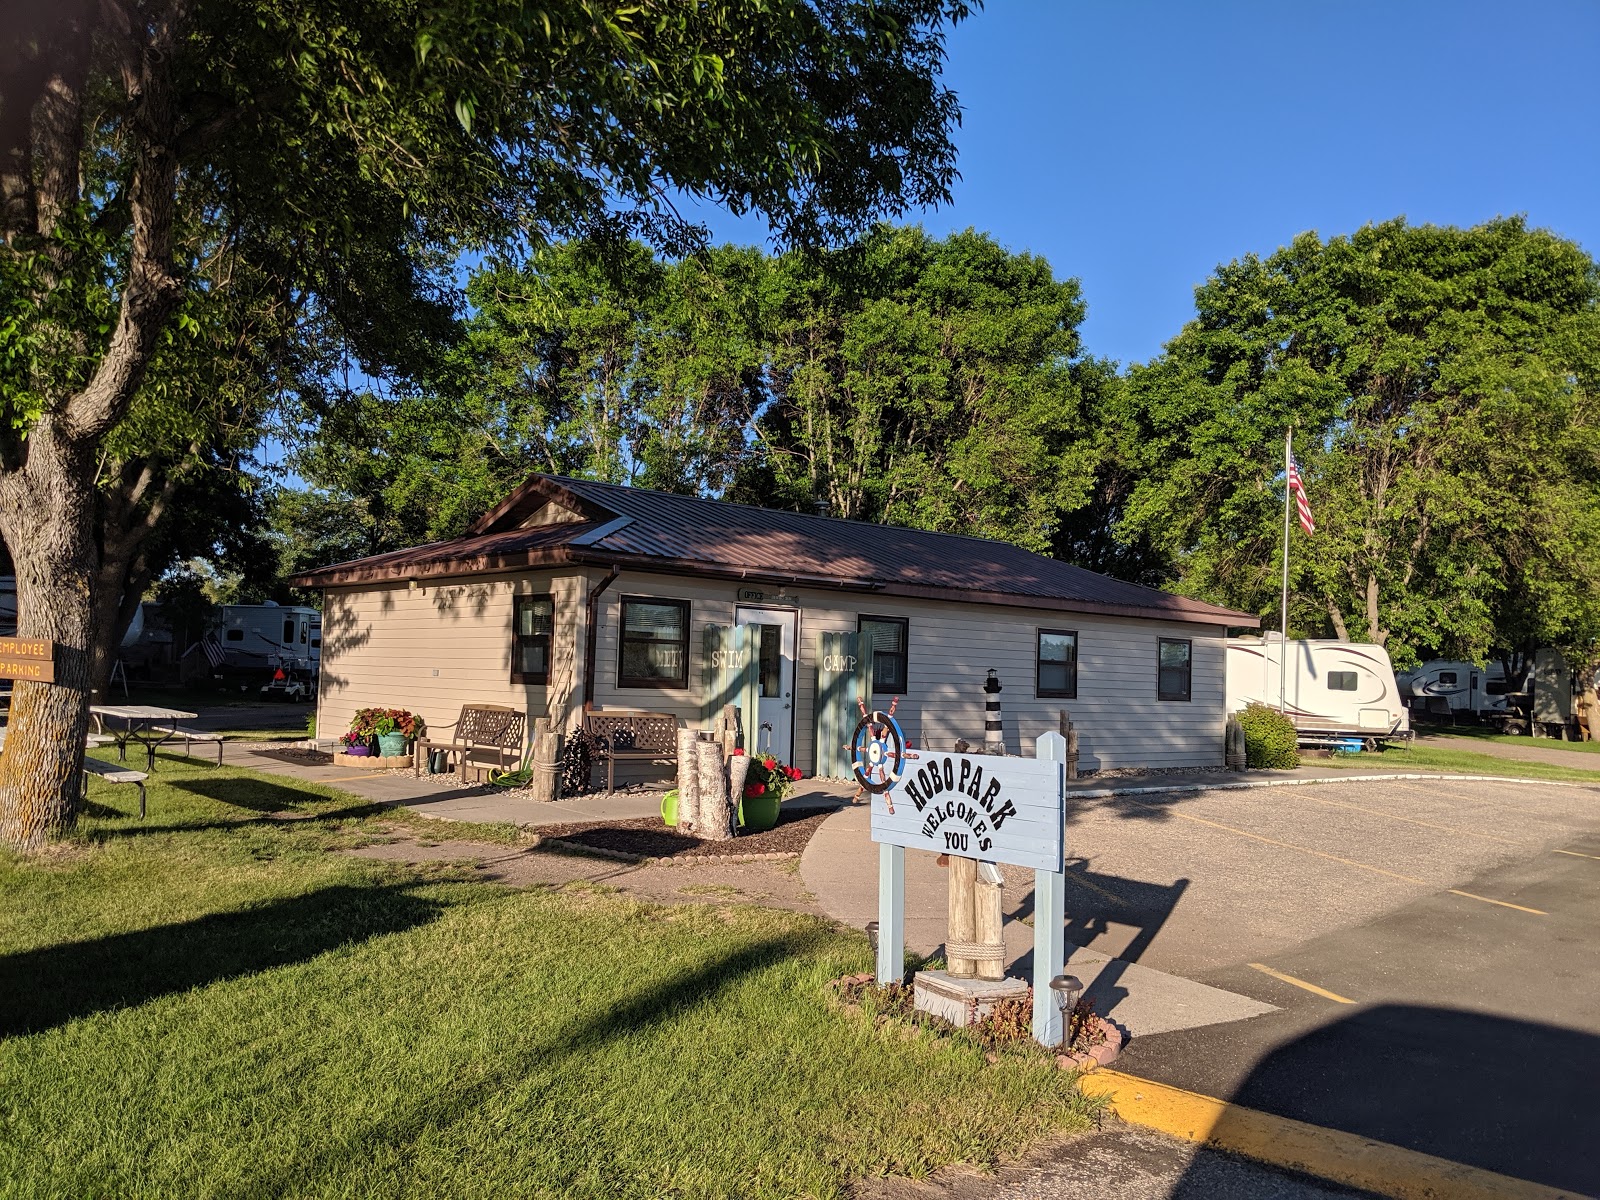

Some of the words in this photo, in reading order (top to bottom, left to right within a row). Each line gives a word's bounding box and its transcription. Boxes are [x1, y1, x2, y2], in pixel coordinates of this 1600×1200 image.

[0, 662, 41, 677] PARKING
[711, 650, 744, 669] SWIM
[823, 655, 858, 672] CAMP
[904, 757, 954, 812] HOBO
[958, 758, 1017, 831] PARK
[921, 801, 993, 852] WELCOMES
[944, 831, 969, 852] YOU
